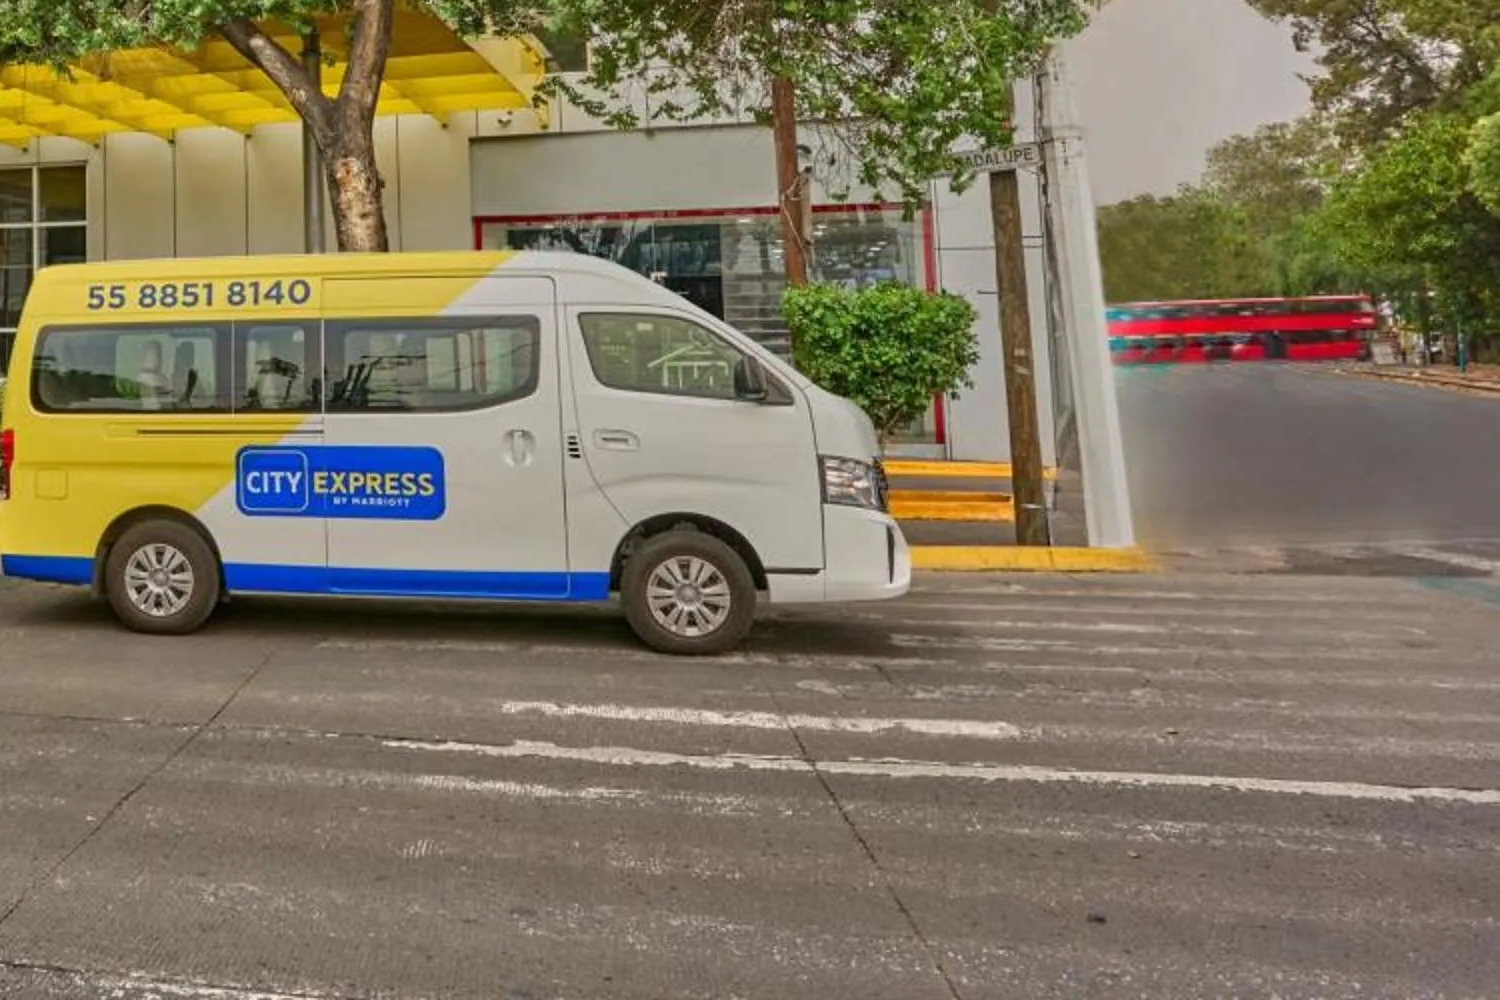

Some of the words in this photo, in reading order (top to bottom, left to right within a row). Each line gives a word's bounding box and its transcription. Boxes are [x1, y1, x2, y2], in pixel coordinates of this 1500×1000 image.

[952, 147, 1034, 168] ADALUPE
[87, 285, 126, 310] 55
[138, 282, 214, 308] 8851
[226, 279, 312, 306] 8140
[246, 471, 302, 494] CITY
[313, 472, 435, 497] EXPRESS
[333, 498, 348, 506] BY
[351, 498, 410, 508] MARRIOTT
